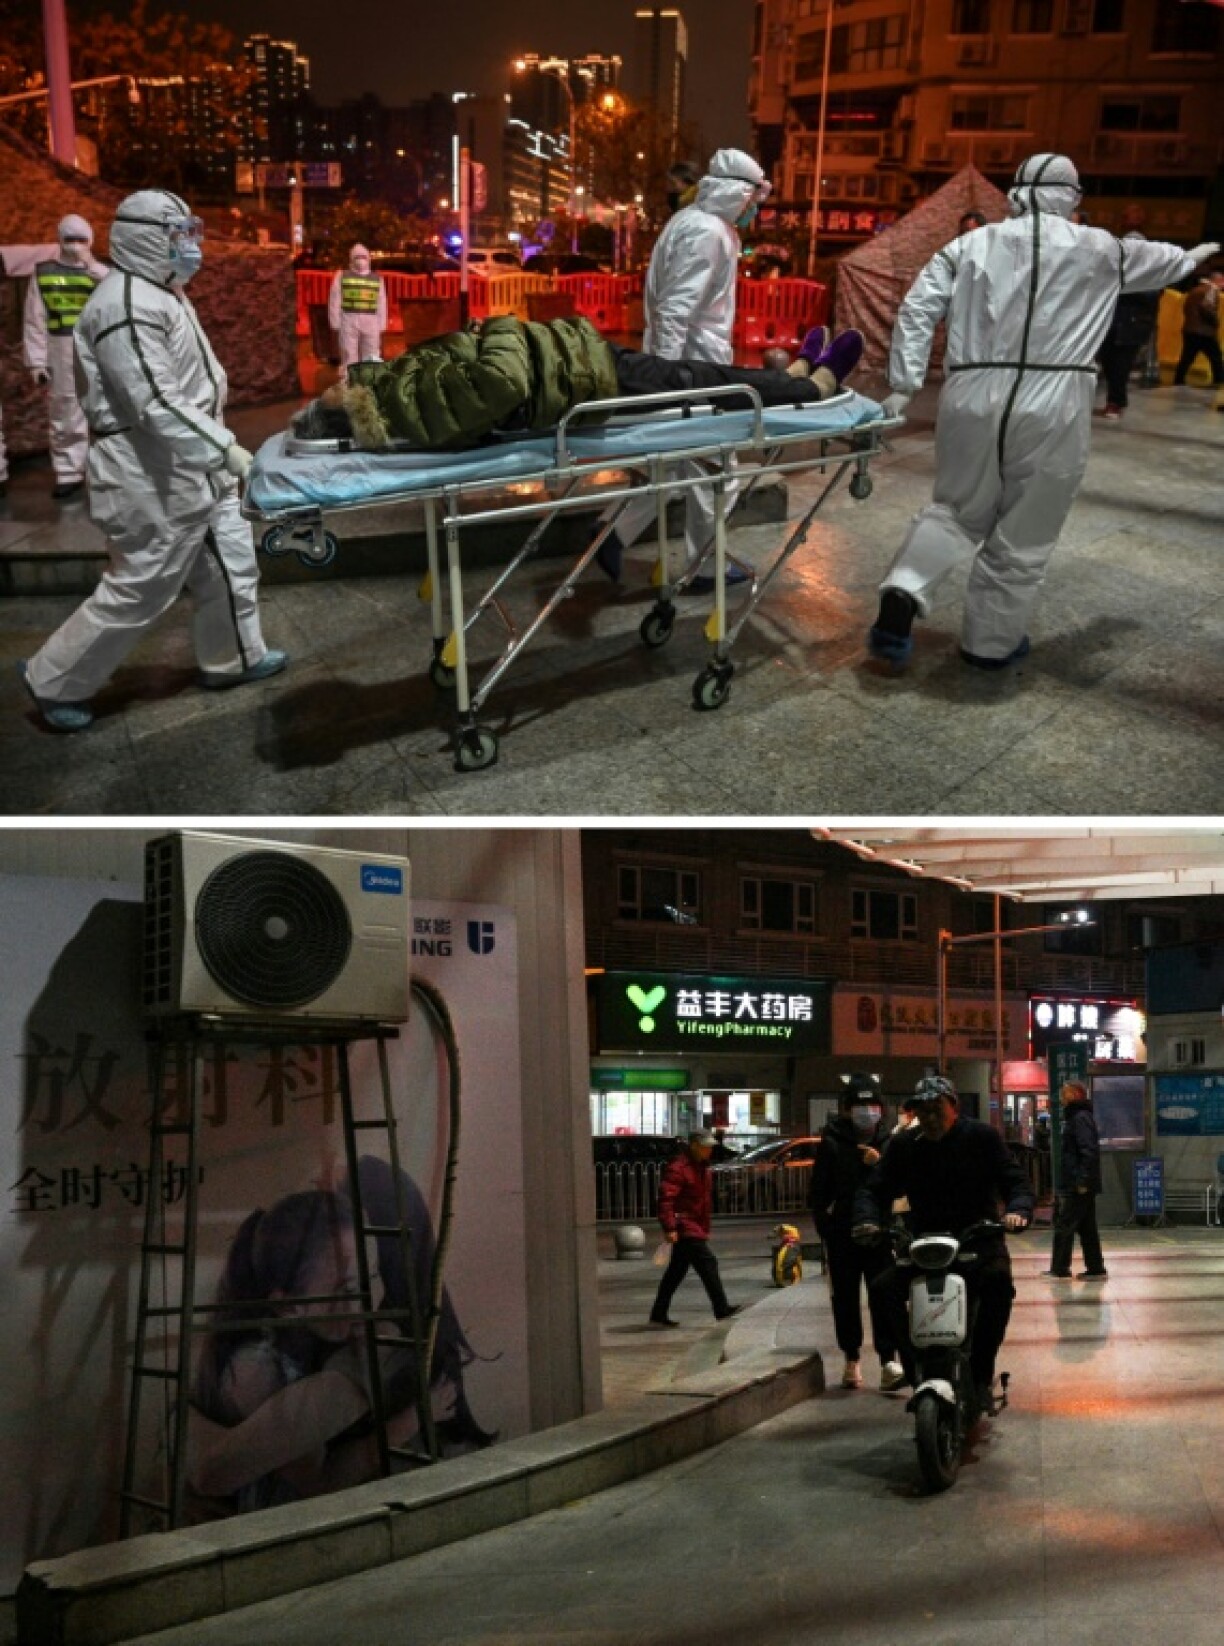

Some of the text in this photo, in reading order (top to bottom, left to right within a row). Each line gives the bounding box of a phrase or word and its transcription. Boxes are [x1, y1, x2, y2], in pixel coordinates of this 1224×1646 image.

[676, 989, 813, 1021] 益丰大药房
